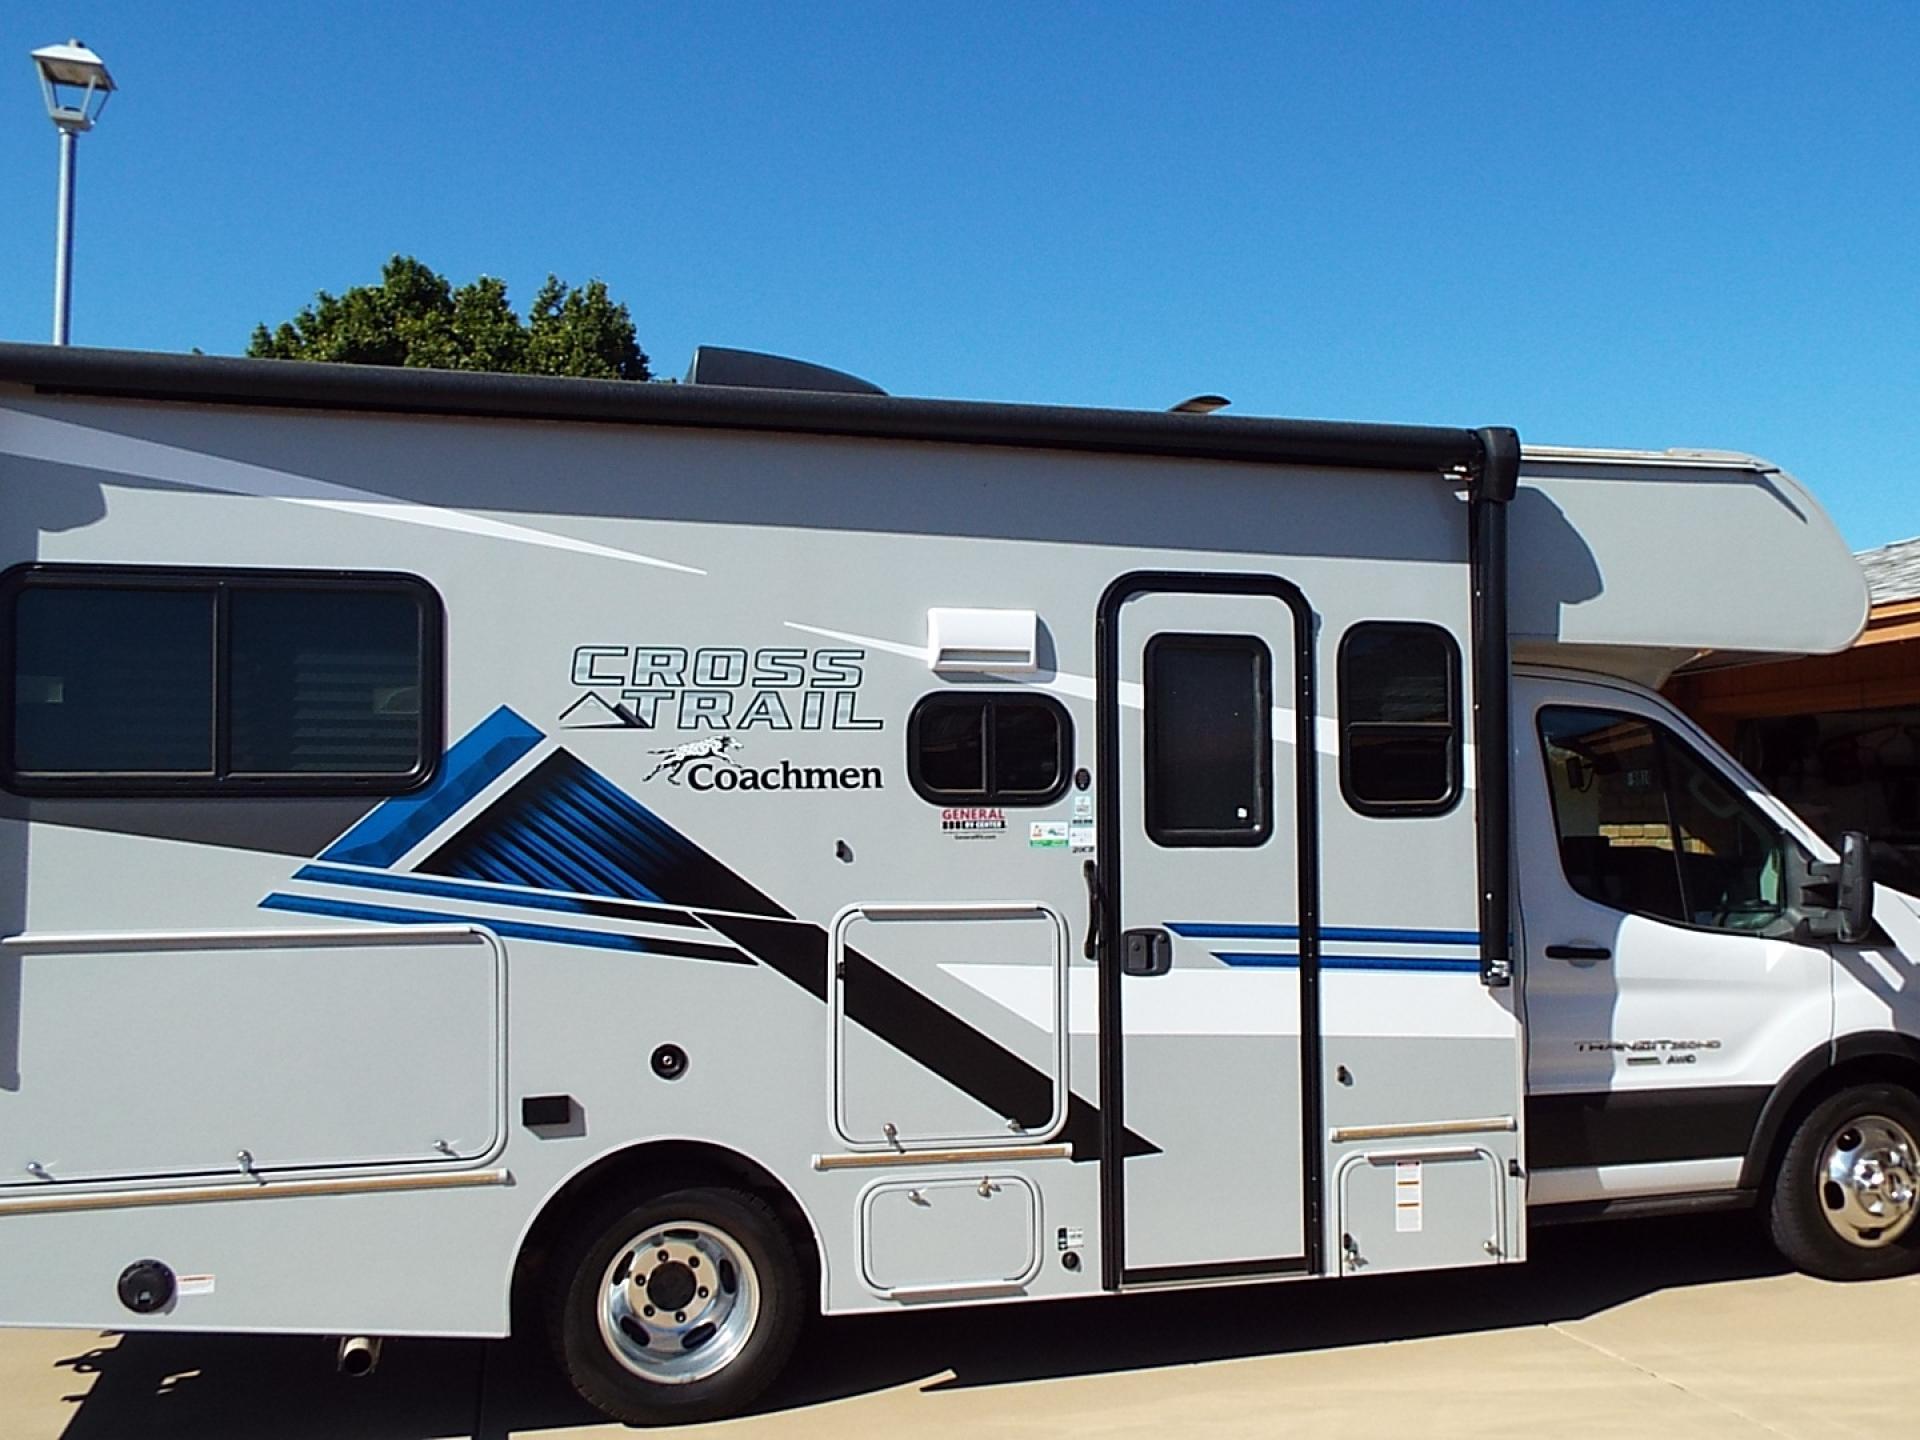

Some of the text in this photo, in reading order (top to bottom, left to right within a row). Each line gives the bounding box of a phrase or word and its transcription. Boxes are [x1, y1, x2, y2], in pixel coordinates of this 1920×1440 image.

[571, 646, 865, 688] CROSS
[620, 689, 884, 730] TRAIL
[687, 760, 884, 791] Coachmen
[942, 808, 1005, 820] GENERAL
